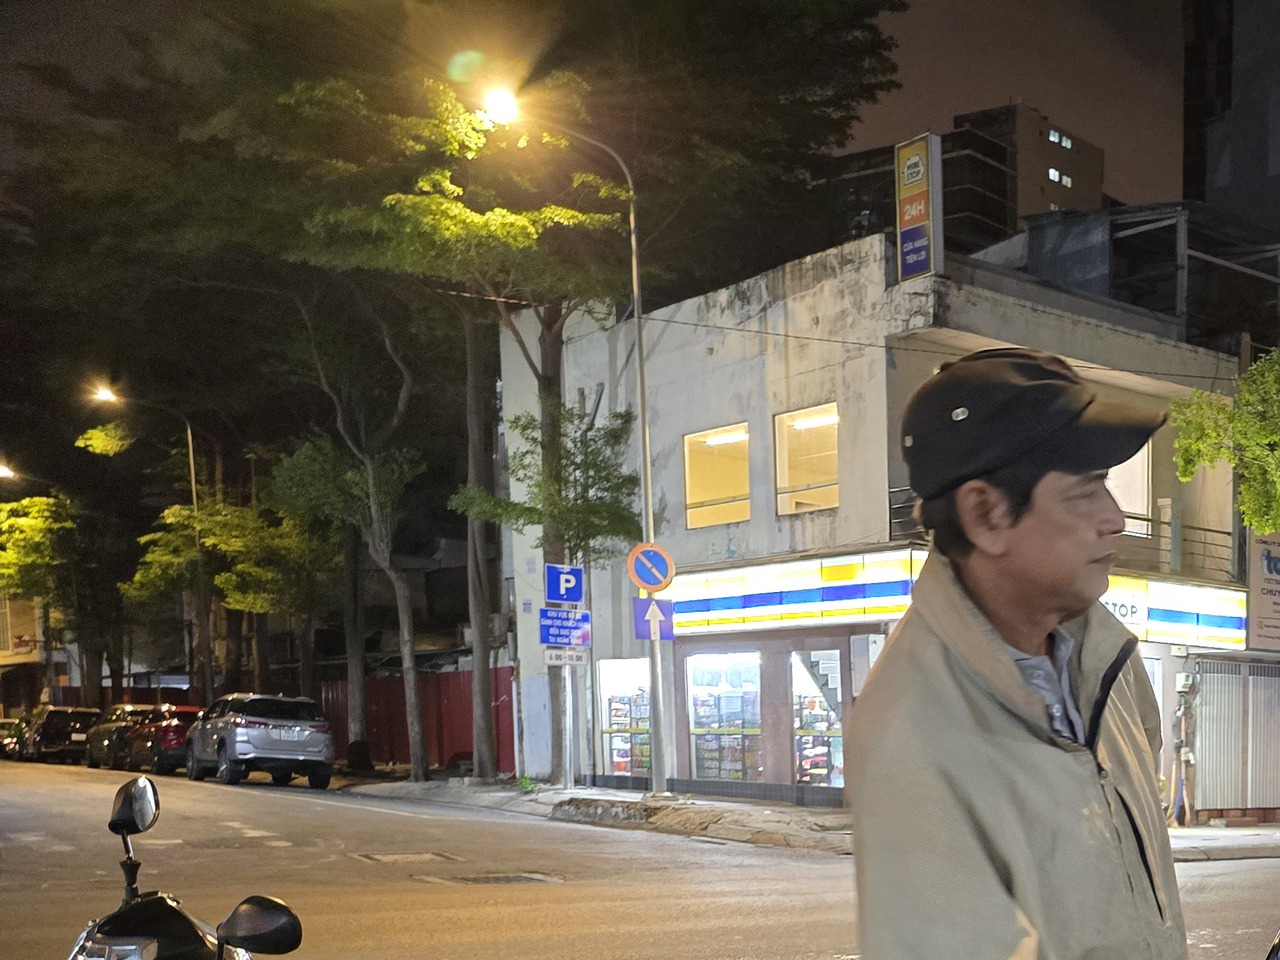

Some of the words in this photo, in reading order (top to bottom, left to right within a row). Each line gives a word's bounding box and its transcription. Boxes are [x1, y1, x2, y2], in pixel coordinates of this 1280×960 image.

[904, 199, 925, 221] 24H
[559, 574, 577, 595] P
[1104, 601, 1138, 618] TOP
